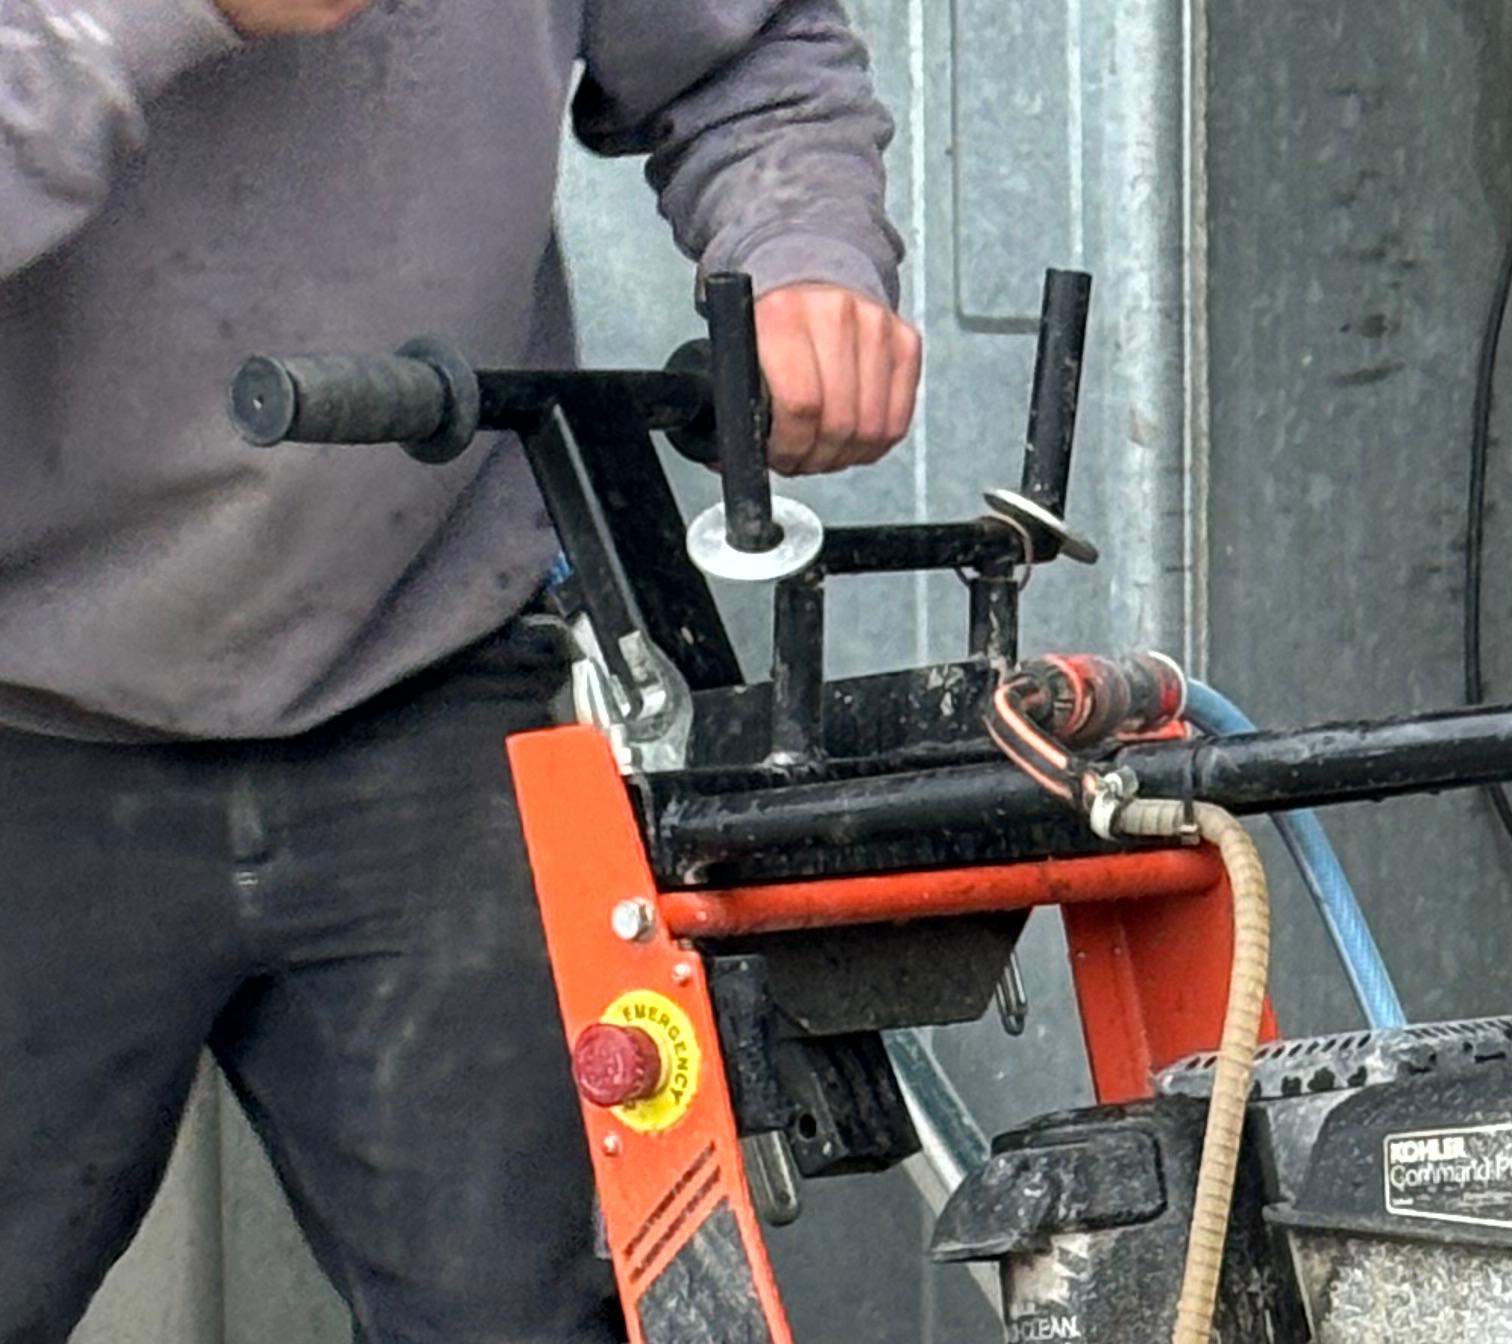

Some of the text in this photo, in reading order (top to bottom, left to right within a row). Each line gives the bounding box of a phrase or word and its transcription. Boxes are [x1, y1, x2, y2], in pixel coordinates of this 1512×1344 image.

[622, 1003, 689, 1105] EMERGENCY
[1390, 1137, 1467, 1163] KOHLER
[1390, 1158, 1490, 1190] Command
